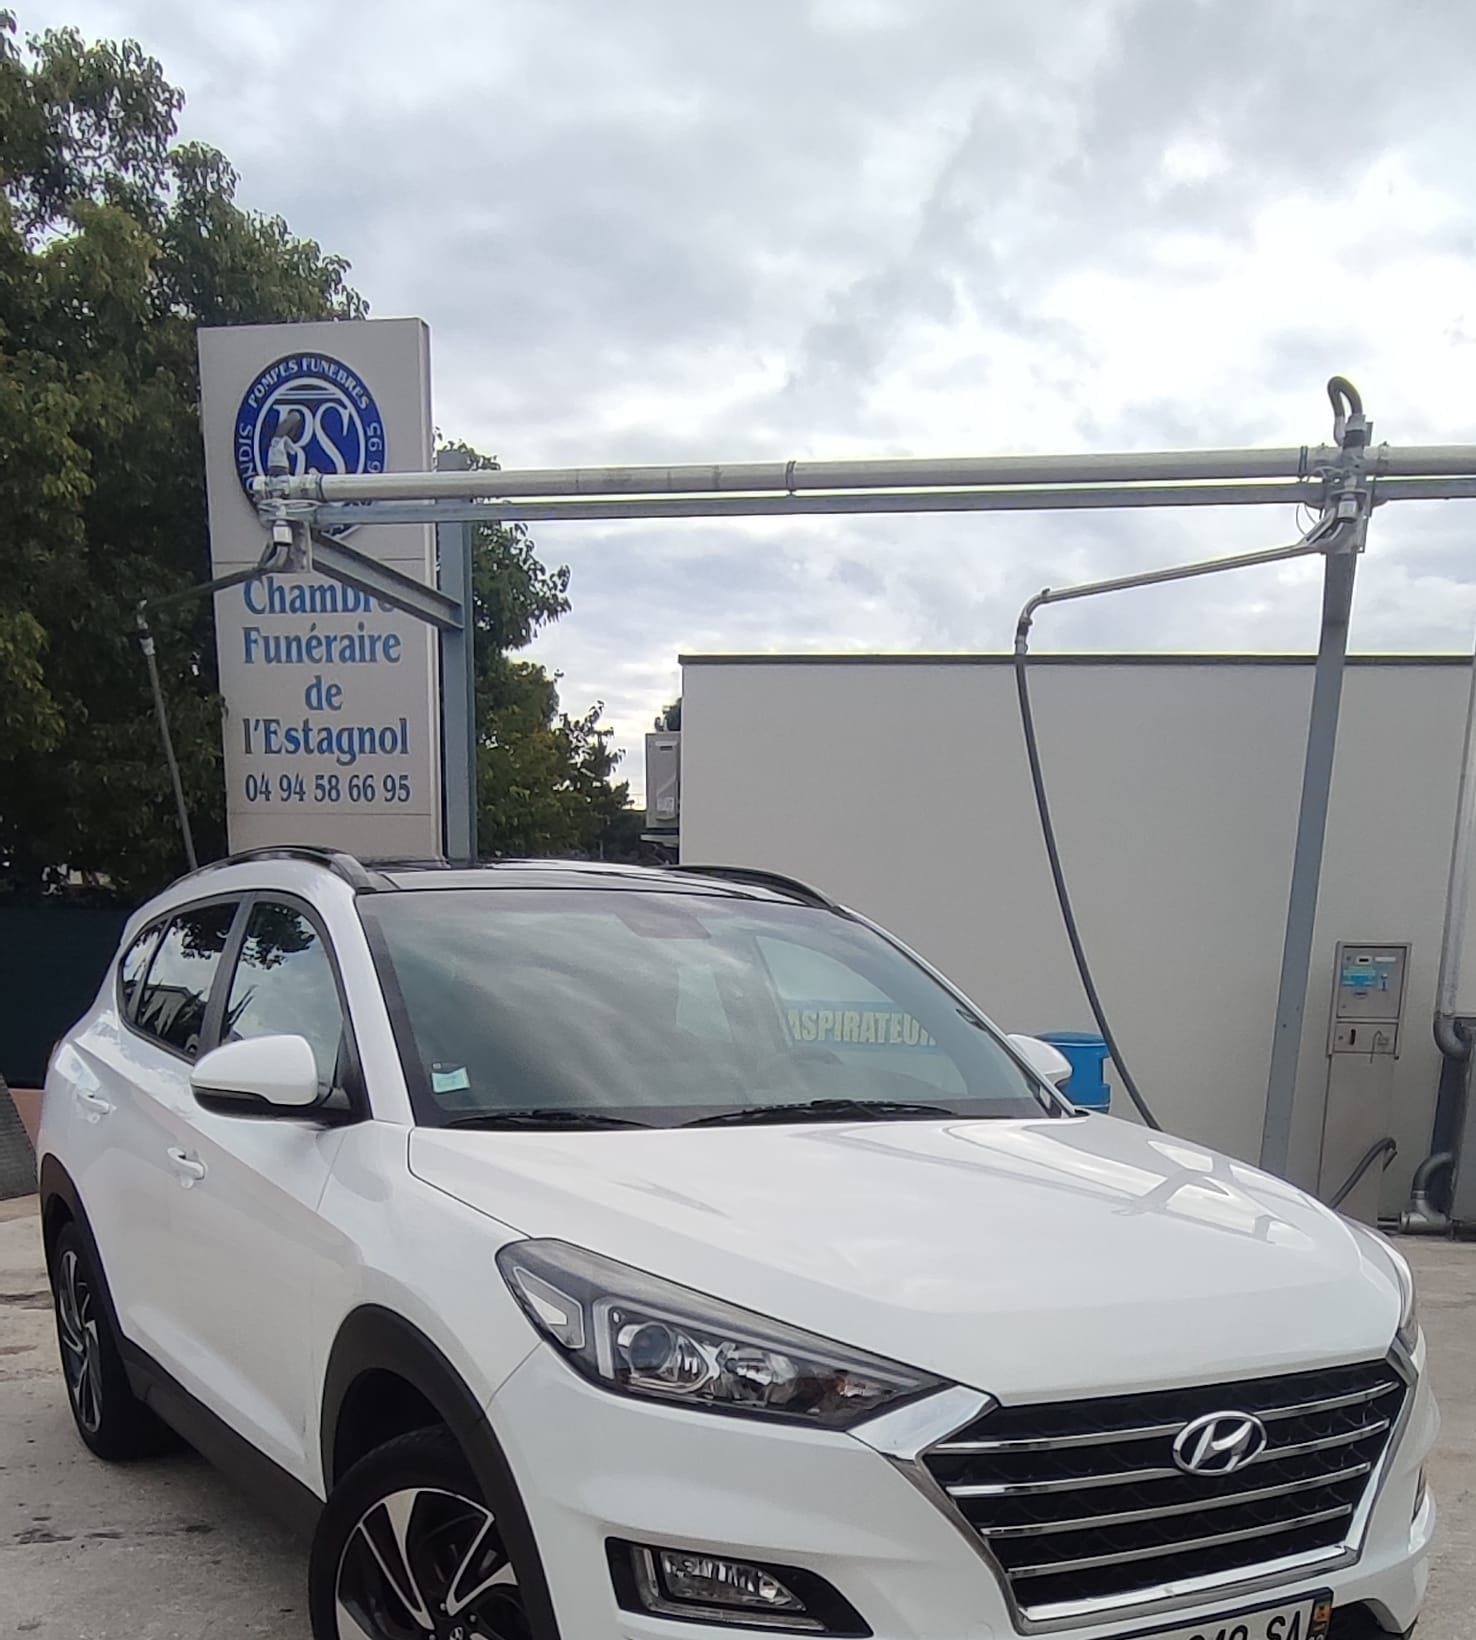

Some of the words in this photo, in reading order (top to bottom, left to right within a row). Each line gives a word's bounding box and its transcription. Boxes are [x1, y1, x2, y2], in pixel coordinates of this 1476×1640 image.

[248, 360, 298, 408] POMPES
[242, 621, 401, 664] Funéraire
[305, 675, 343, 711] de
[242, 718, 409, 766] l'Estagnol
[245, 773, 272, 802] 04
[279, 773, 306, 802] 94
[314, 774, 341, 802] 58
[349, 775, 376, 802] 66
[383, 775, 411, 802] 95
